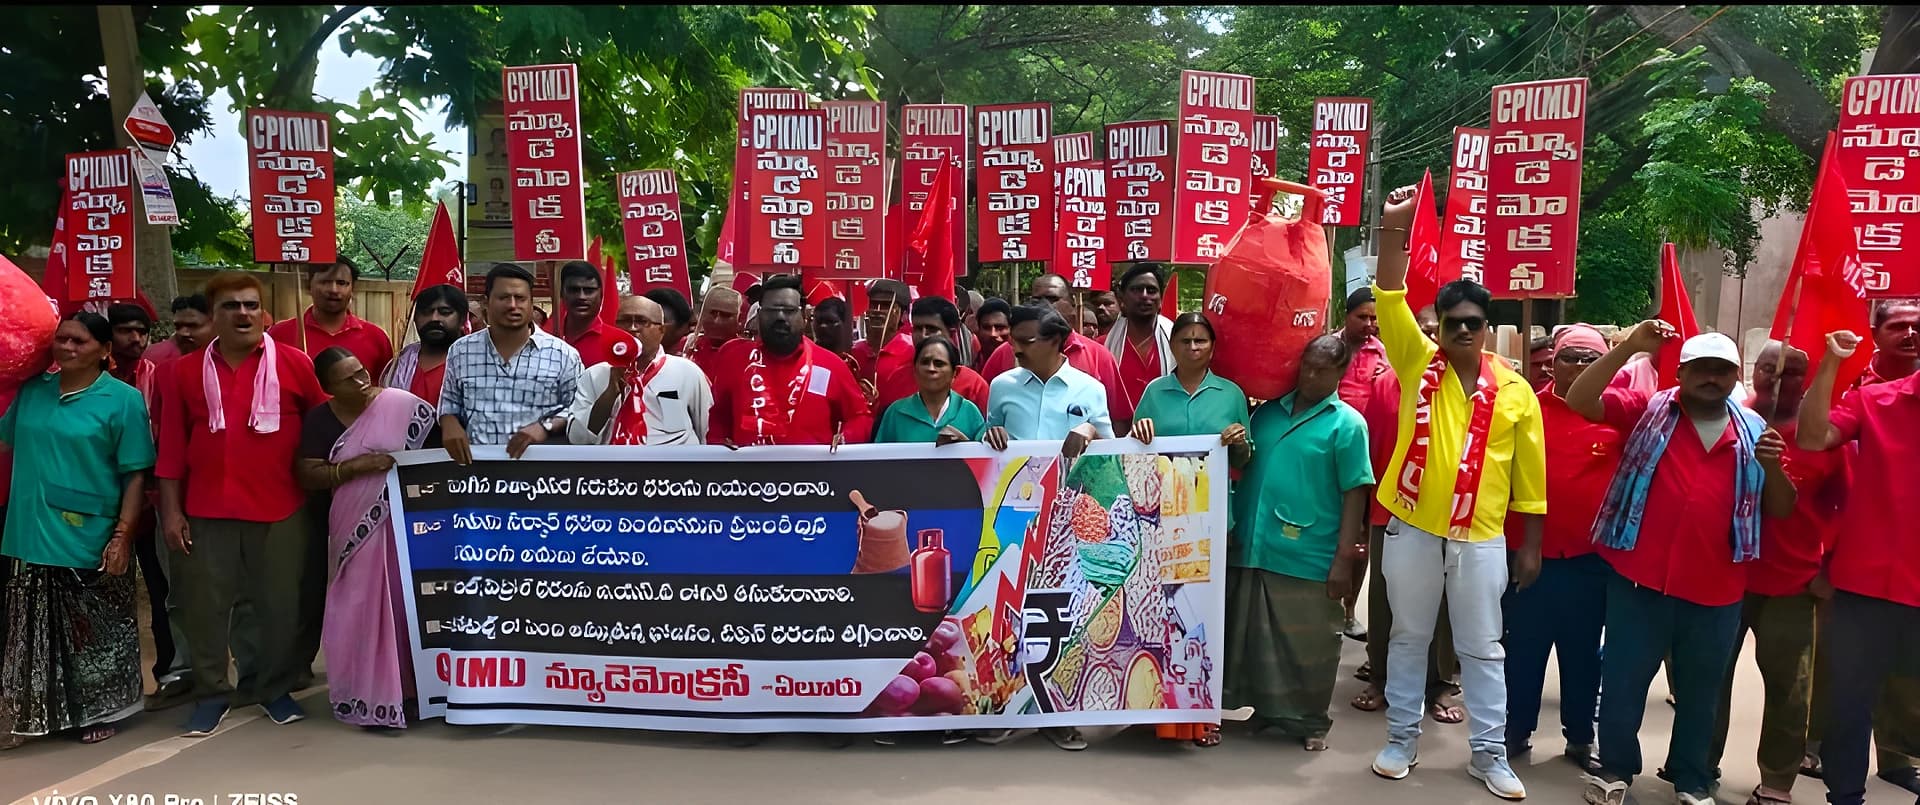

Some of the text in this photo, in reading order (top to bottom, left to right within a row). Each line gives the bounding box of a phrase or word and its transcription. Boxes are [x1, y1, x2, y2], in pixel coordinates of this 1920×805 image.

[507, 69, 571, 102] CPI(ML)
[1187, 75, 1250, 110] CPI(ML)
[1497, 84, 1582, 123] CPI(ML)
[252, 115, 328, 152] CPI(ML)
[753, 113, 822, 151] CPI(ML)
[979, 108, 1047, 146] CPI(ML)
[1109, 124, 1168, 160] CPI(ML)
[69, 154, 129, 192] CPI(ML)
[545, 661, 750, 704] న్యూడెమోక్రసీ
